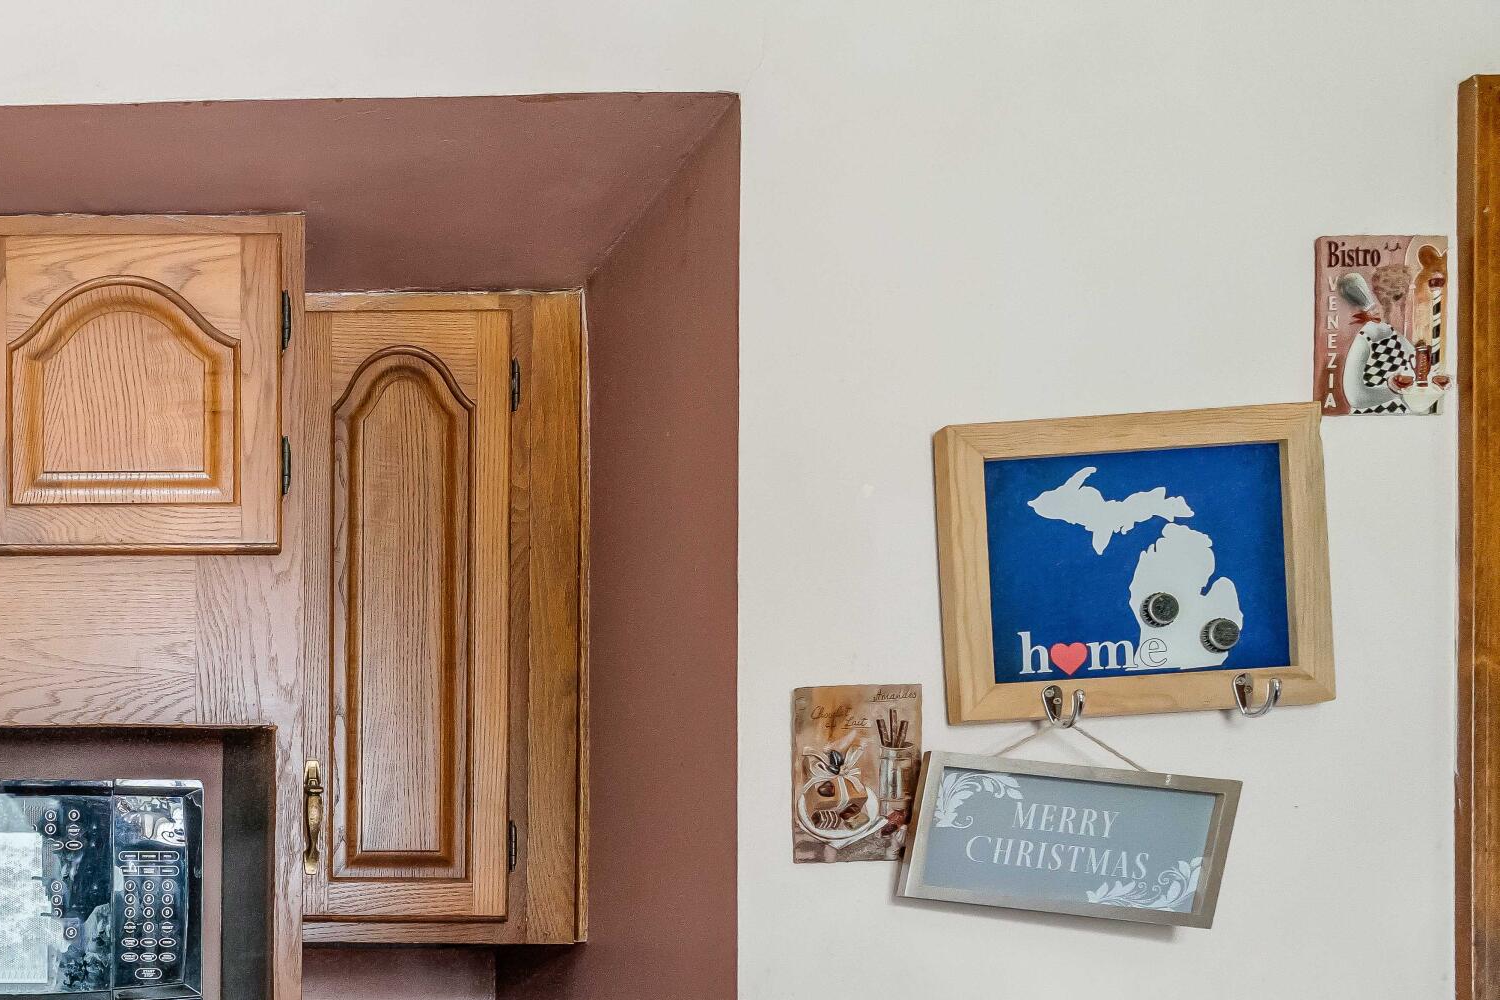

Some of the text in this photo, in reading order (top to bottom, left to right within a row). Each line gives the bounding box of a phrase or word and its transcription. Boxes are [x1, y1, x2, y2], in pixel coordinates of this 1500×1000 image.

[1327, 241, 1381, 268] Bistro
[1324, 276, 1339, 408] VENEZIA
[1012, 801, 1121, 839] MERRY
[965, 835, 1149, 881] CHRISTMAS
